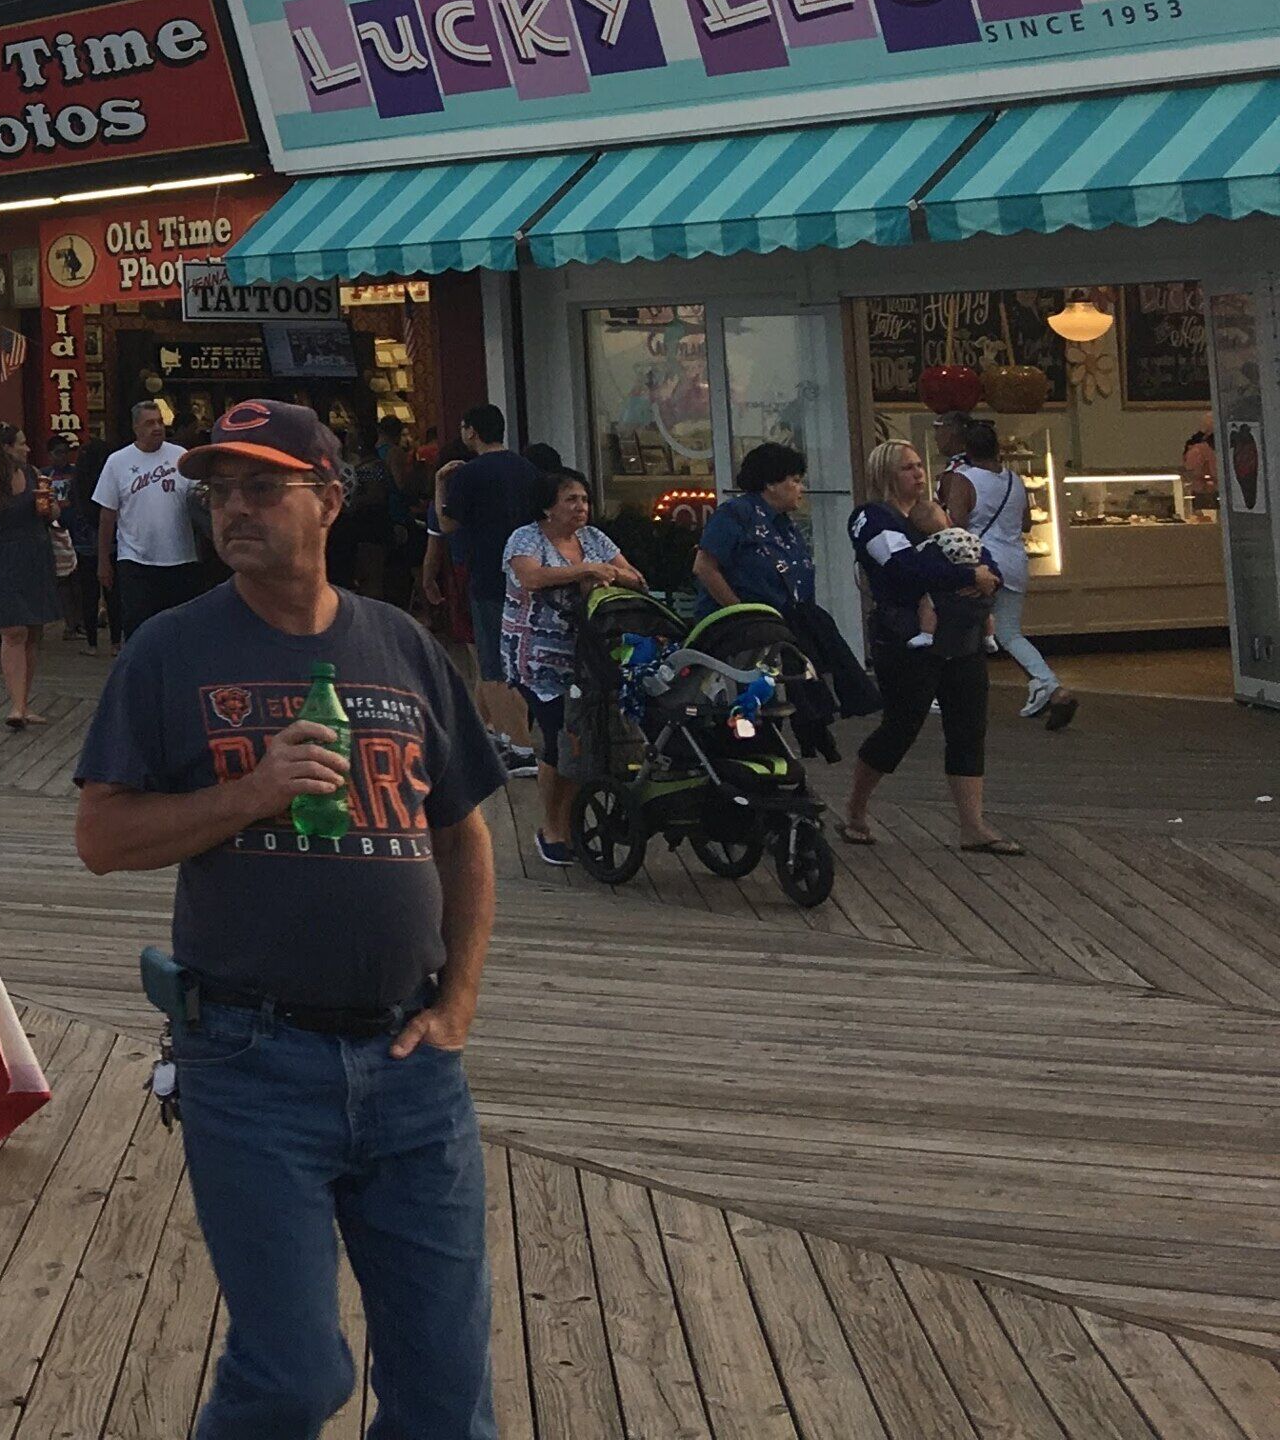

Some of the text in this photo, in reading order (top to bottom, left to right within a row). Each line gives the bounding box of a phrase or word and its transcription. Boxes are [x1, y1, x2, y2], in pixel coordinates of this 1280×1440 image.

[985, 13, 1085, 43] SINCE
[5, 18, 208, 89] Time
[106, 215, 232, 253] Old Time
[120, 254, 221, 288] Phot
[193, 286, 333, 313] TATTOOS
[50, 306, 76, 357] ld
[226, 357, 262, 370] TIME
[346, 697, 374, 708] NFC
